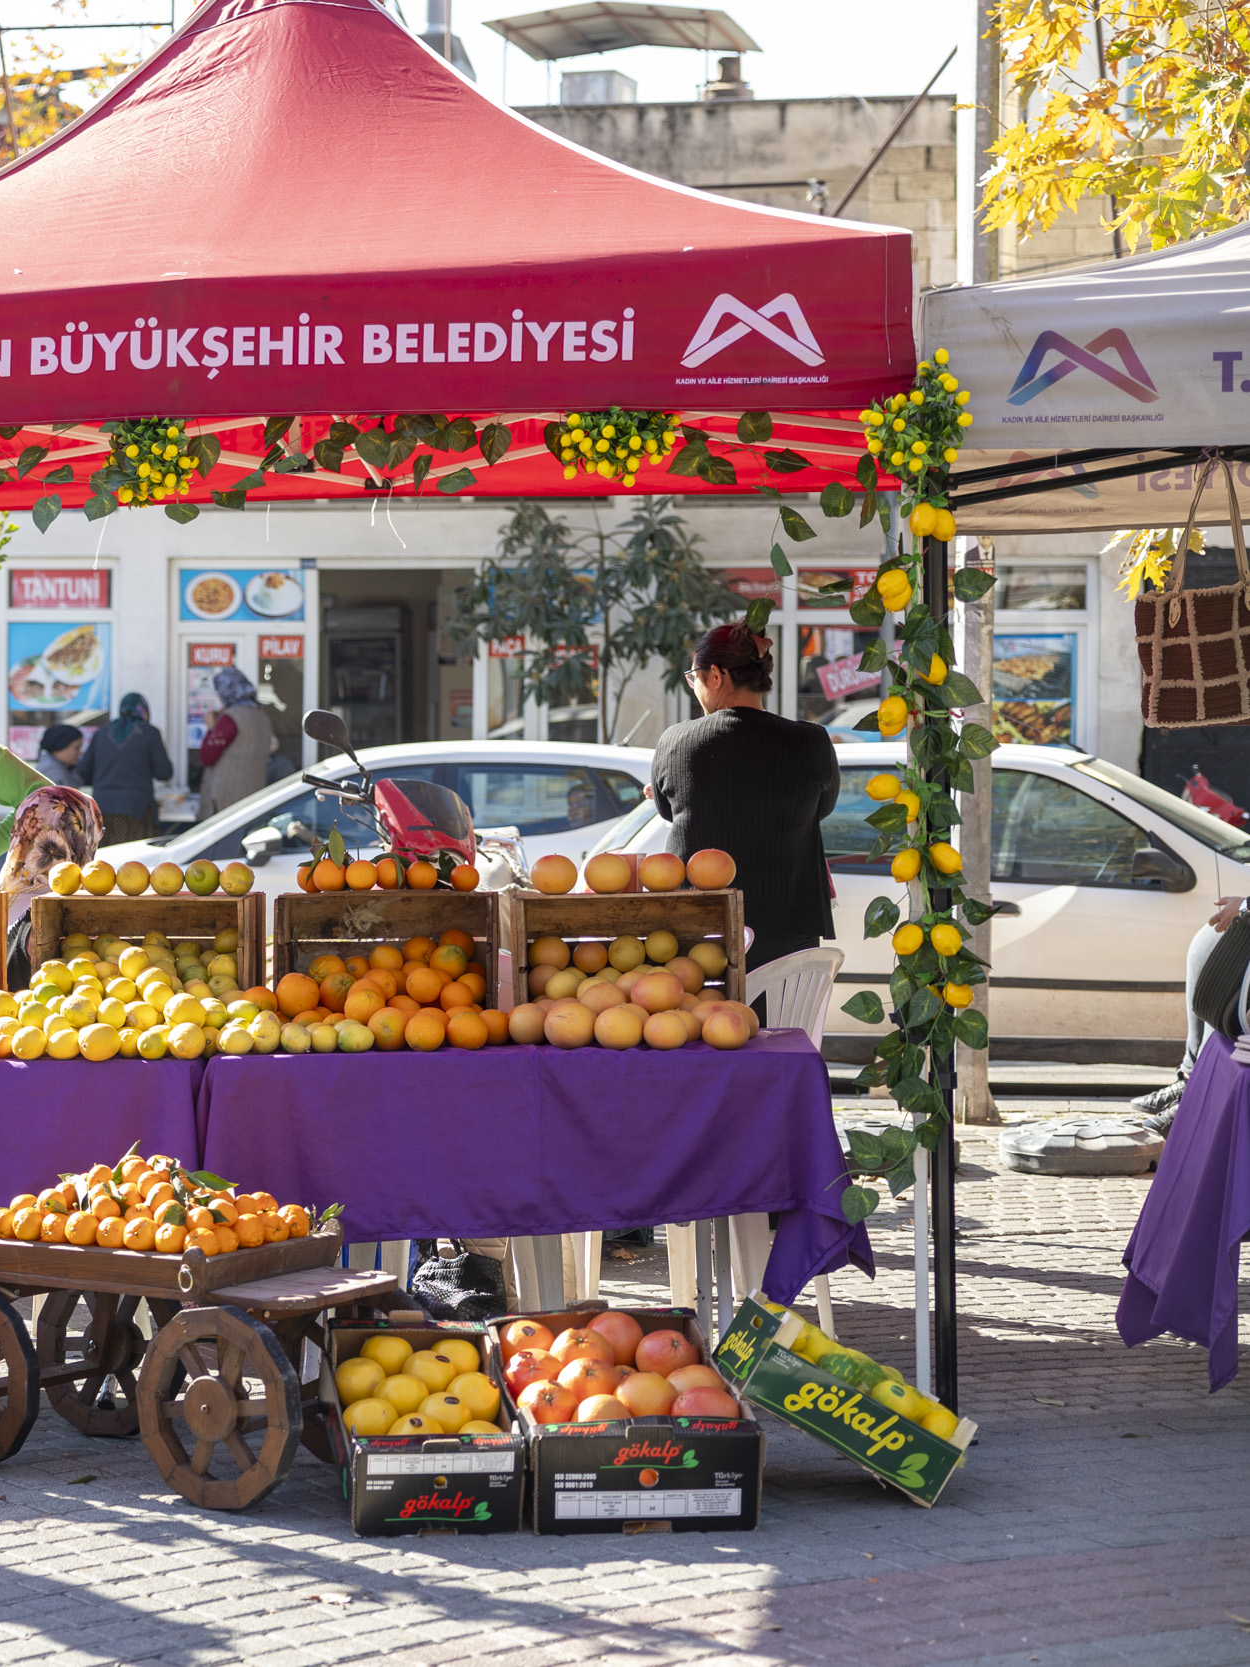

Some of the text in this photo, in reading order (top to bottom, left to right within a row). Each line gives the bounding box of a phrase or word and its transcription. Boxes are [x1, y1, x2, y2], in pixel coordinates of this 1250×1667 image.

[30, 312, 345, 380] BÜYÜKŞEHİR
[363, 307, 635, 364] BELEDİYESİ
[675, 377, 696, 385] KADIN
[707, 376, 722, 384] AİLE
[723, 376, 762, 384] HİZMETLERİ
[1034, 414, 1049, 423] AİLE
[1050, 413, 1092, 423] HİZMETLERİ
[1092, 413, 1121, 422] DAİRESİ
[1121, 412, 1164, 423] BAŞKANLIĞI
[21, 573, 100, 600] TANTUNİ
[193, 647, 230, 664] KURU
[262, 636, 300, 656] PİLAV
[491, 637, 523, 656] PAÇA
[784, 1382, 906, 1456] gökalp
[613, 1441, 681, 1466] gökalp
[714, 1472, 743, 1480] Türkiye
[400, 1491, 472, 1518] gökalp
